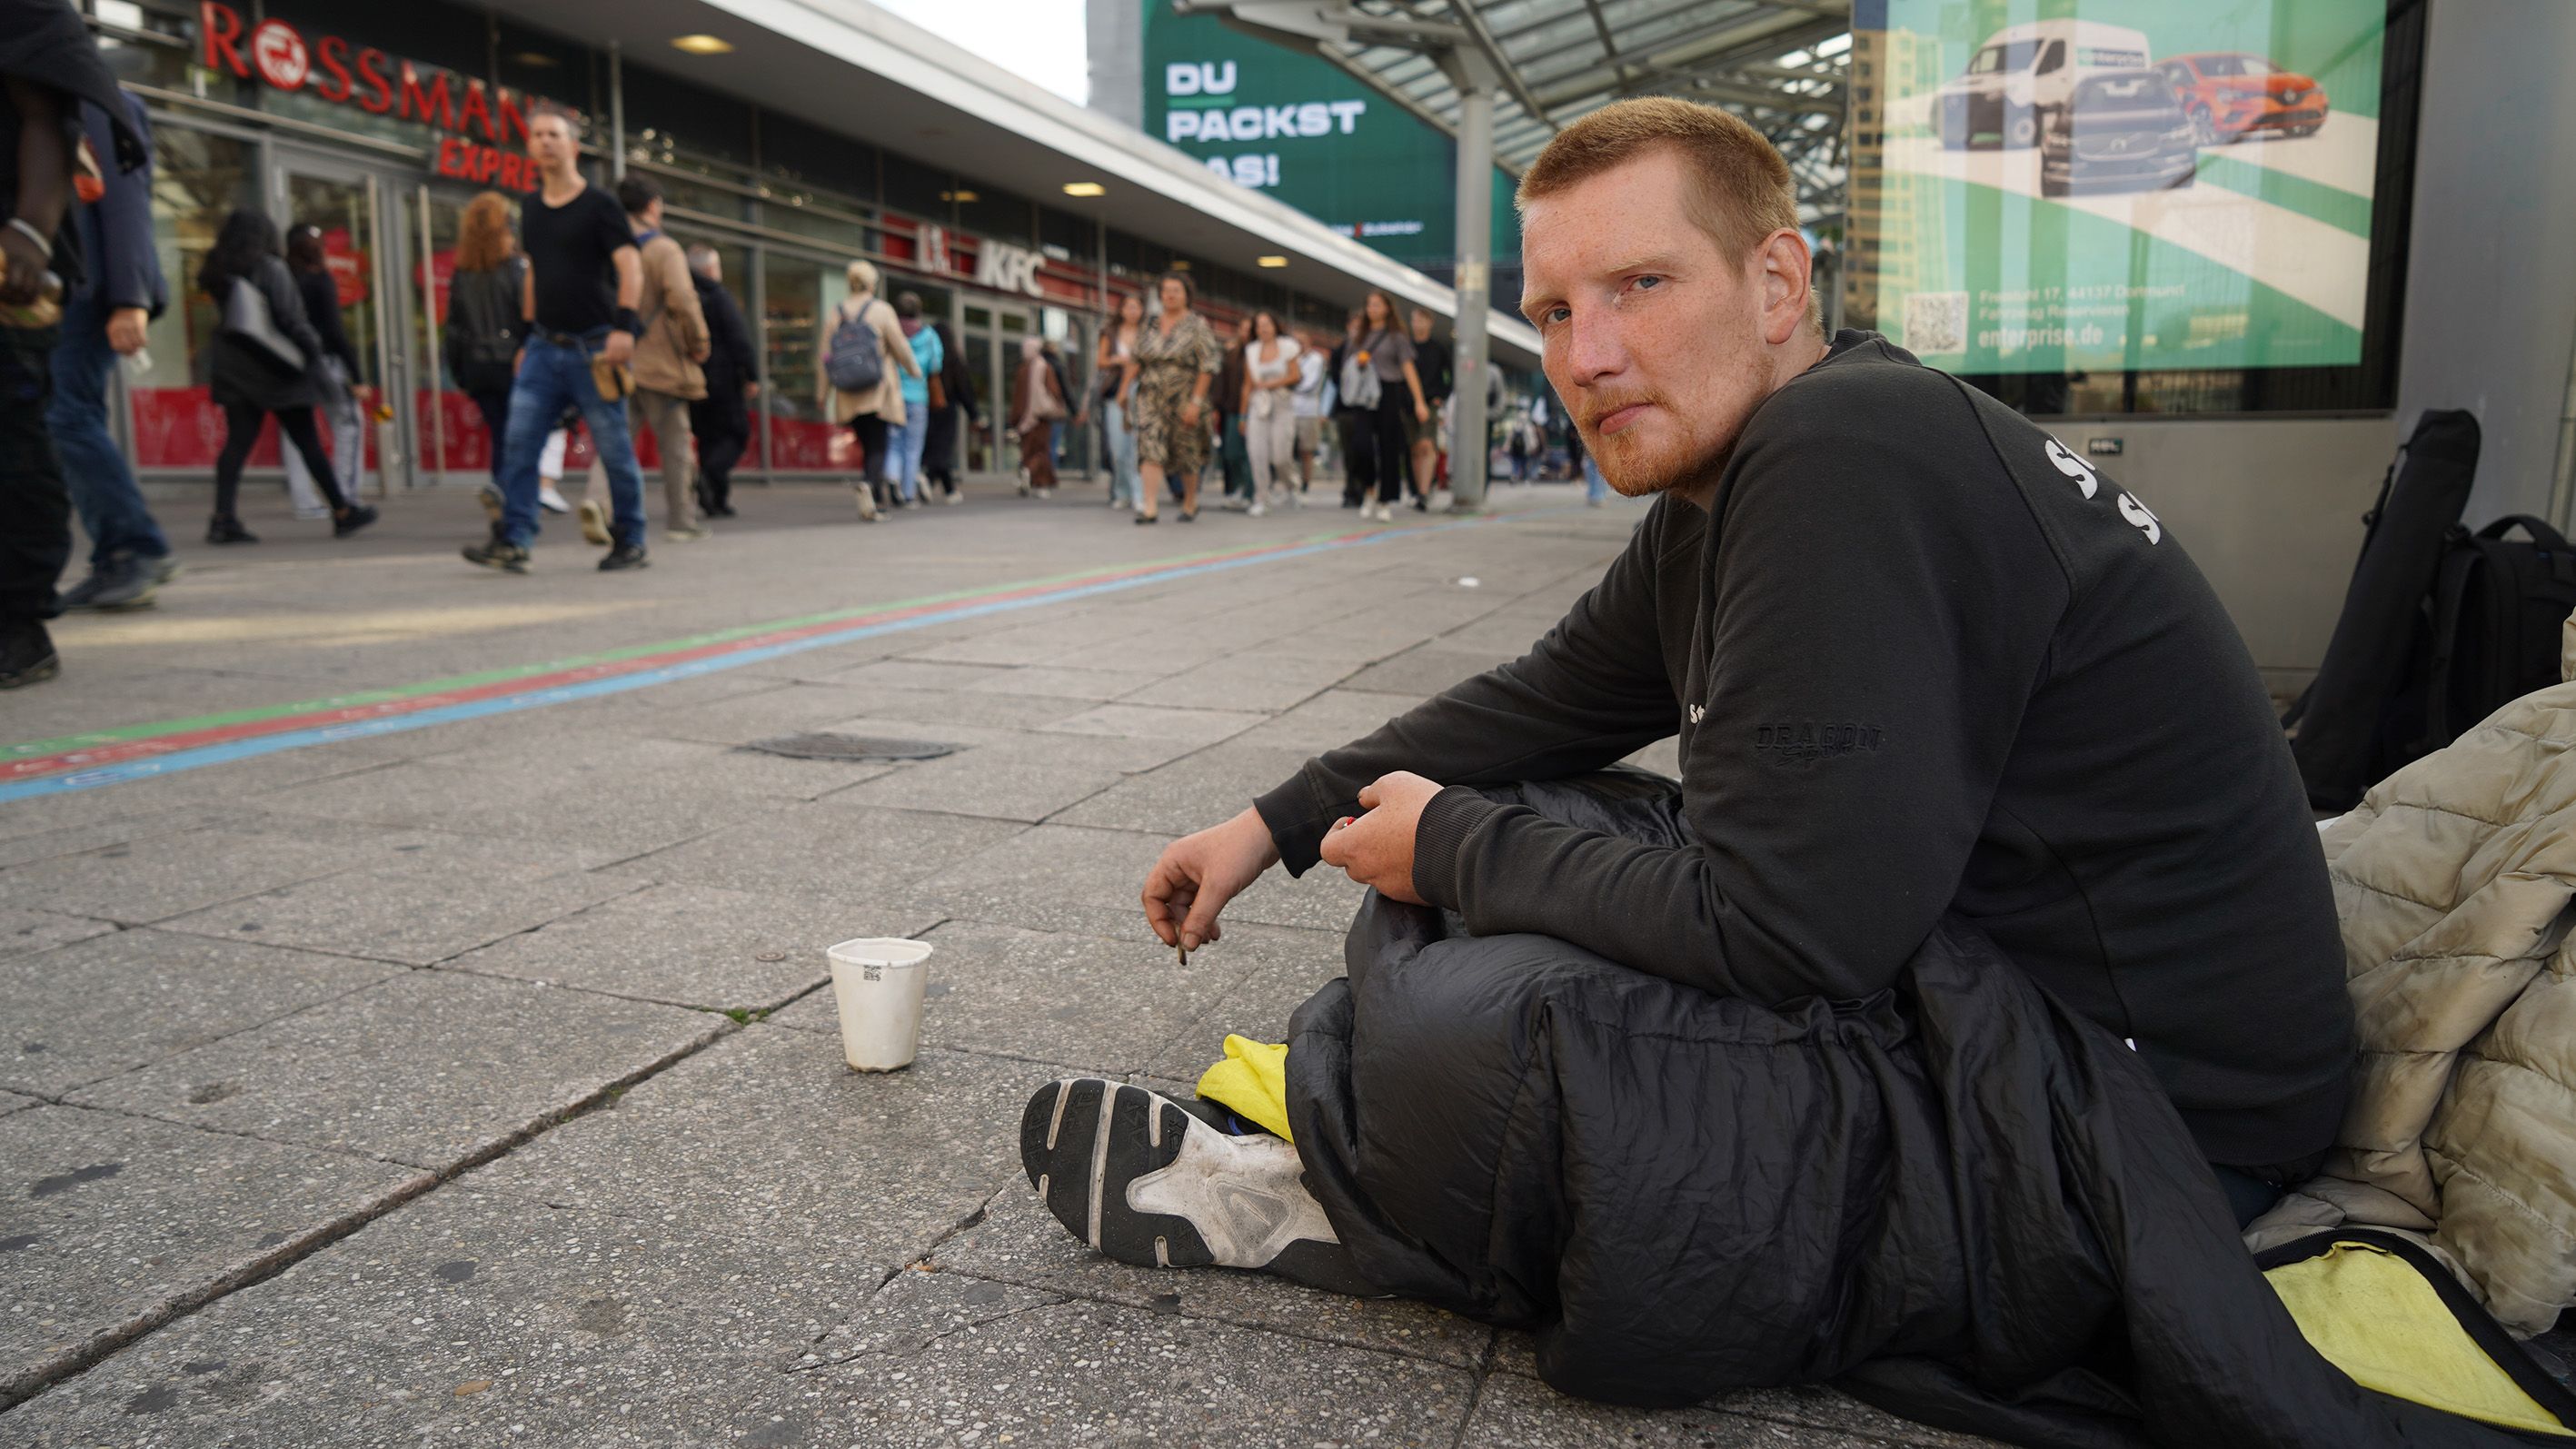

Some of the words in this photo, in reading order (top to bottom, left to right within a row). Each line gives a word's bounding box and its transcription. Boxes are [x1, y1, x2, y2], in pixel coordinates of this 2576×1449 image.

[201, 0, 549, 144] ROSSMAN
[1167, 61, 1237, 95] DU
[1166, 100, 1366, 144] PACKST
[438, 137, 540, 193] EXPRE
[1207, 154, 1281, 188] AS!
[979, 240, 1047, 298] KFC
[1978, 322, 2104, 352] enterprise.de
[2045, 433, 2098, 501] S
